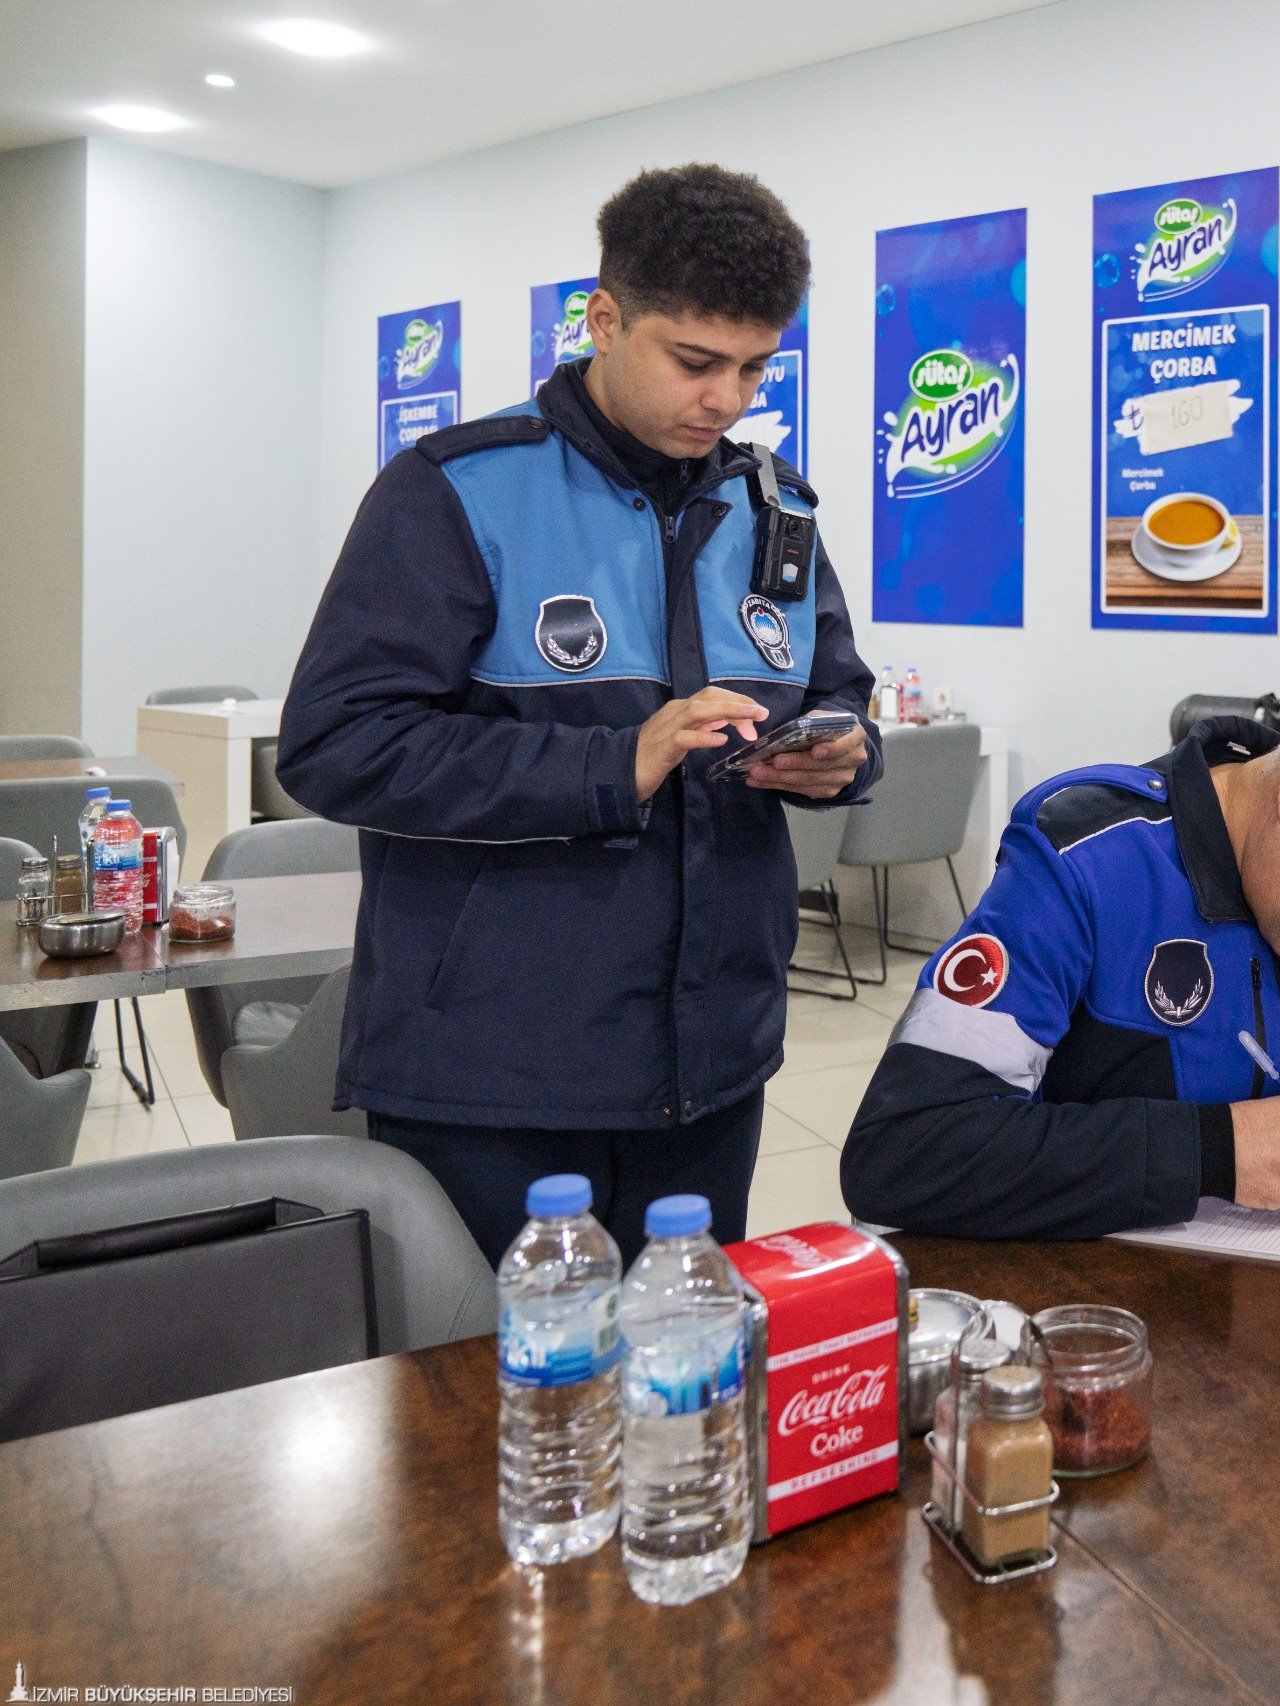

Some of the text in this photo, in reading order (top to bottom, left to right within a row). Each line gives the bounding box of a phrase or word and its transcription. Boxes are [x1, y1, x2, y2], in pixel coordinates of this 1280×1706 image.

[1149, 218, 1222, 278] Ayran
[1132, 323, 1236, 352] MERCİMEK
[1150, 355, 1217, 384] ÇORBA
[901, 382, 999, 462] Ayran
[1171, 396, 1204, 429] 160
[810, 1425, 863, 1457] Coke
